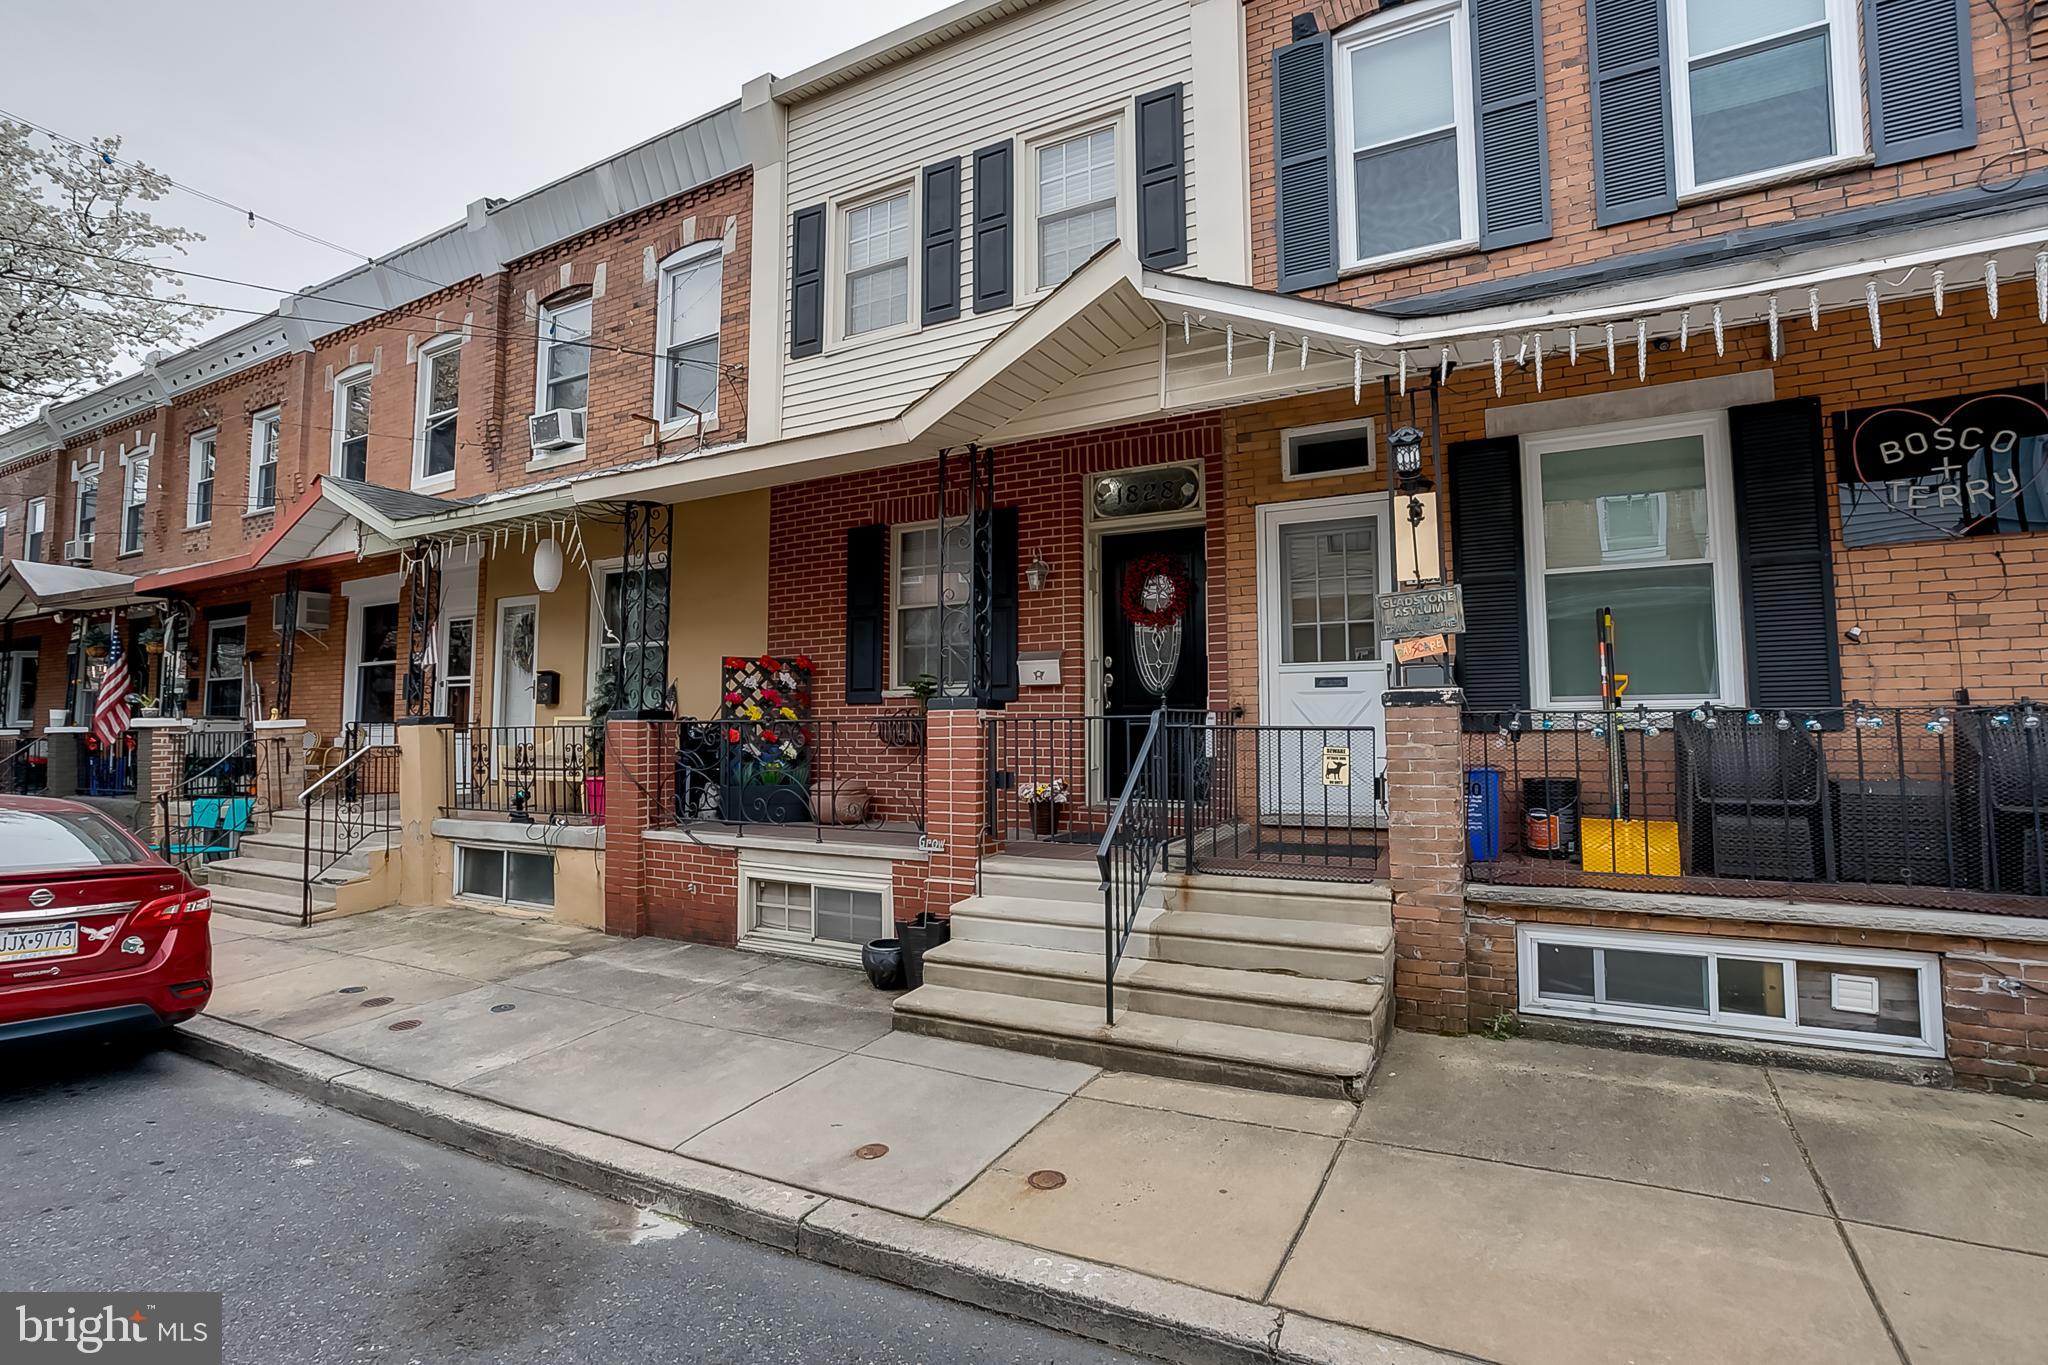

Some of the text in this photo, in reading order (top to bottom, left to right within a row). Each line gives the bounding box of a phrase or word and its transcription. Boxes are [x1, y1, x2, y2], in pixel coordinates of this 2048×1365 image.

[1879, 427, 2018, 464] BOSCO
[1931, 456, 1963, 480] +
[1116, 480, 1176, 505] 1828
[1885, 467, 2020, 509] TERRY
[1381, 592, 1454, 609] GLADSTONE
[1394, 603, 1444, 617] ASYLUM
[919, 835, 945, 849] Grow
